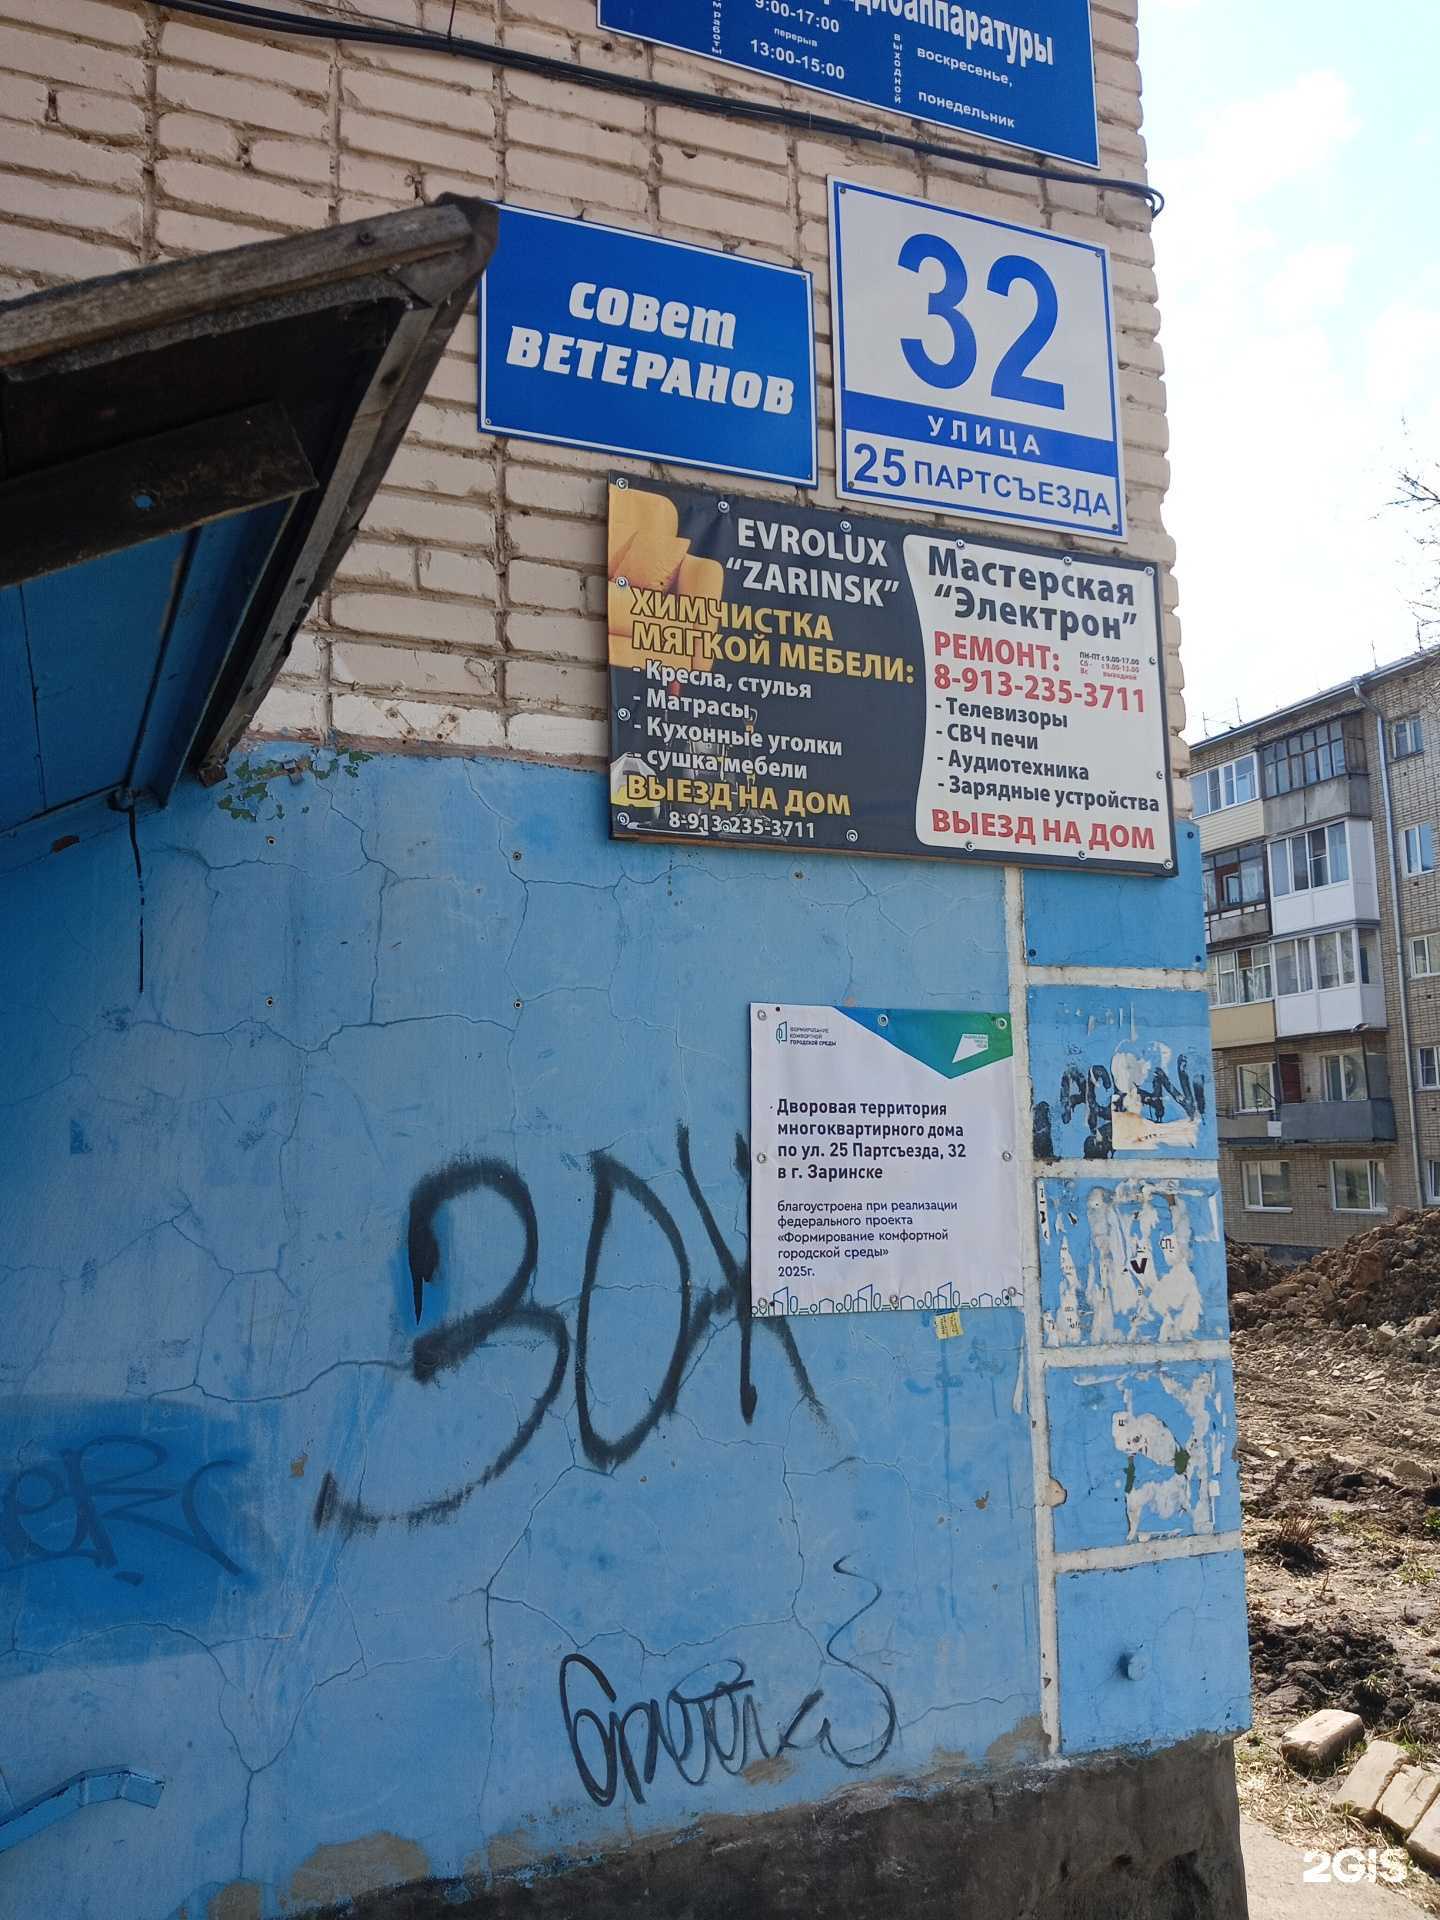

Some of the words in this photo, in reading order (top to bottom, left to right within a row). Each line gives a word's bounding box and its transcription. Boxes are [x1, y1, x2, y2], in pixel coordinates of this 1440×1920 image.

[711, 11, 722, 56] работы
[755, 0, 840, 33] 9:00-17:00
[823, 0, 1054, 68] оаппаратуры
[774, 27, 818, 48] перерыв
[750, 39, 845, 80] 13:00-15:00
[893, 33, 903, 104] выходной
[917, 47, 1013, 88] воскресенье,
[918, 91, 1015, 129] понедельник
[897, 233, 1065, 411] 32
[506, 326, 794, 415] ВЕТЕРАНОВ
[927, 414, 1040, 456] УЛИЦА
[854, 442, 907, 487] 25
[914, 460, 1111, 517] ПАРТСЪЕЗДА
[738, 518, 888, 567] EVROLUX
[929, 545, 1134, 606] Мастерская
[631, 588, 833, 641] ХИМЧИСТКА
[632, 622, 770, 666] МЯГКОЙ
[779, 645, 915, 684] МЕБЕЛИ:
[934, 630, 1060, 672] РЕМОНТ:
[646, 659, 732, 691] Кресла,
[738, 676, 811, 698] стулья
[934, 664, 1145, 712] 8-913-235-3711
[946, 698, 1068, 730] Телевизоры
[647, 717, 762, 748] Кухонные
[768, 734, 842, 756] уголки
[947, 723, 986, 745] СВЧ
[992, 730, 1038, 750] печи
[648, 749, 714, 772] сушка
[724, 758, 807, 779] мебели
[948, 750, 1089, 781] Аудиотехника
[627, 774, 732, 811] ВЫЕЗД
[739, 787, 778, 809] НА
[785, 792, 850, 817] ДОМ
[950, 775, 1050, 803] Зарядные
[1055, 789, 1159, 813] устройства
[669, 811, 814, 839] 8-913-235-3711
[932, 808, 1035, 845] ВЫЕЗД
[1043, 818, 1081, 844] НА
[1089, 823, 1154, 851] ДОМ
[777, 1098, 856, 1116] Дворовая
[862, 1101, 947, 1118] территория
[778, 1123, 924, 1140] многоквартирного
[928, 1124, 963, 1138] дома
[778, 1145, 797, 1157] по
[801, 1145, 824, 1162] ул.
[830, 1143, 848, 1157] 25
[853, 1143, 944, 1160] Партсъезда,
[949, 1143, 966, 1157] 32
[778, 1168, 786, 1179] в
[791, 1168, 802, 1179] г.
[808, 1164, 883, 1182] Заринске
[777, 1200, 862, 1214] благоустроена
[866, 1203, 887, 1213] при
[891, 1201, 957, 1212] реализации
[777, 1215, 861, 1229] федерального
[866, 1216, 913, 1227] проекта
[778, 1231, 874, 1244] «Формирование
[879, 1230, 949, 1243] комфортной
[778, 1246, 839, 1260] городской
[844, 1247, 888, 1259] среды»
[778, 1266, 815, 1277] 2025г.
